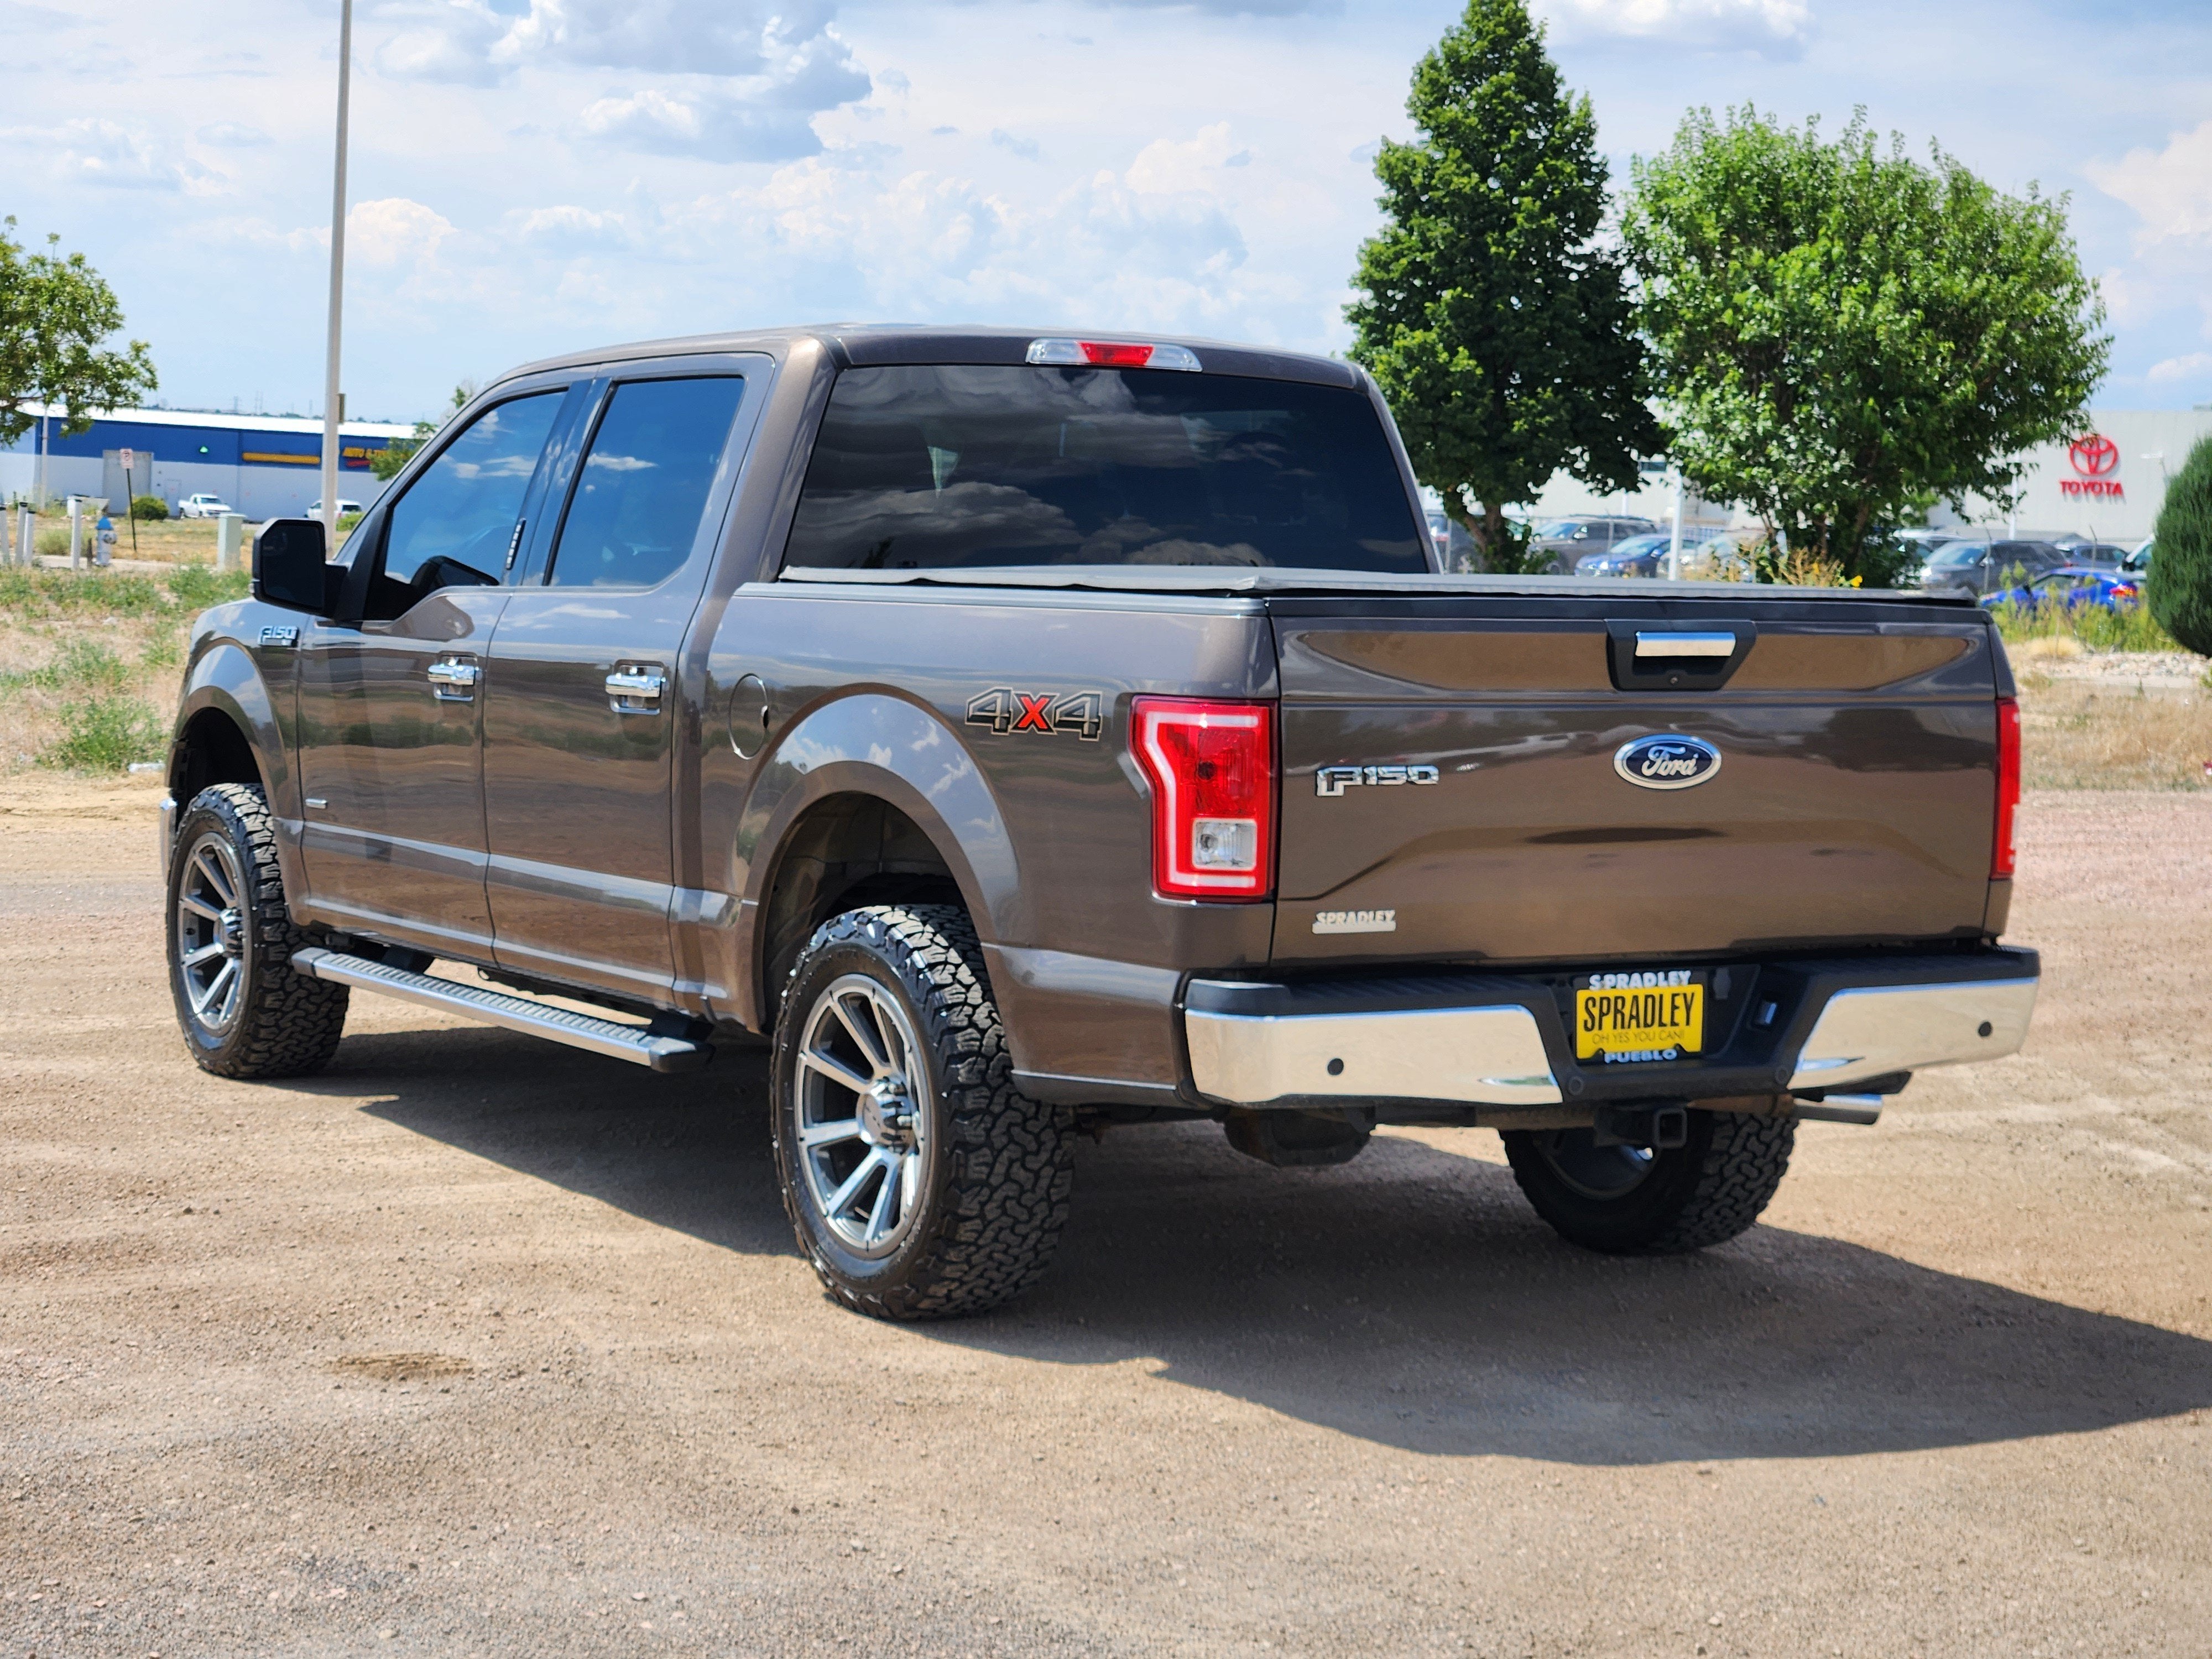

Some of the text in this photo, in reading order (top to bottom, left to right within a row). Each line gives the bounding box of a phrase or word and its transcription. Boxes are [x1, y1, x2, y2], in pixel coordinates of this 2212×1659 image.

[2059, 481, 2122, 495] TOYOTA
[1641, 745, 1698, 776] Ford
[1316, 766, 1439, 796] F150
[1316, 910, 1395, 925] SPRADLEY
[1589, 970, 1691, 990] SPRADLEY
[1583, 992, 1695, 1032] SPRADLEY
[1592, 1033, 1609, 1045] OH
[1613, 1032, 1630, 1044] YES
[1634, 1030, 1656, 1042] YOU
[1604, 1048, 1678, 1063] PUEBLO
